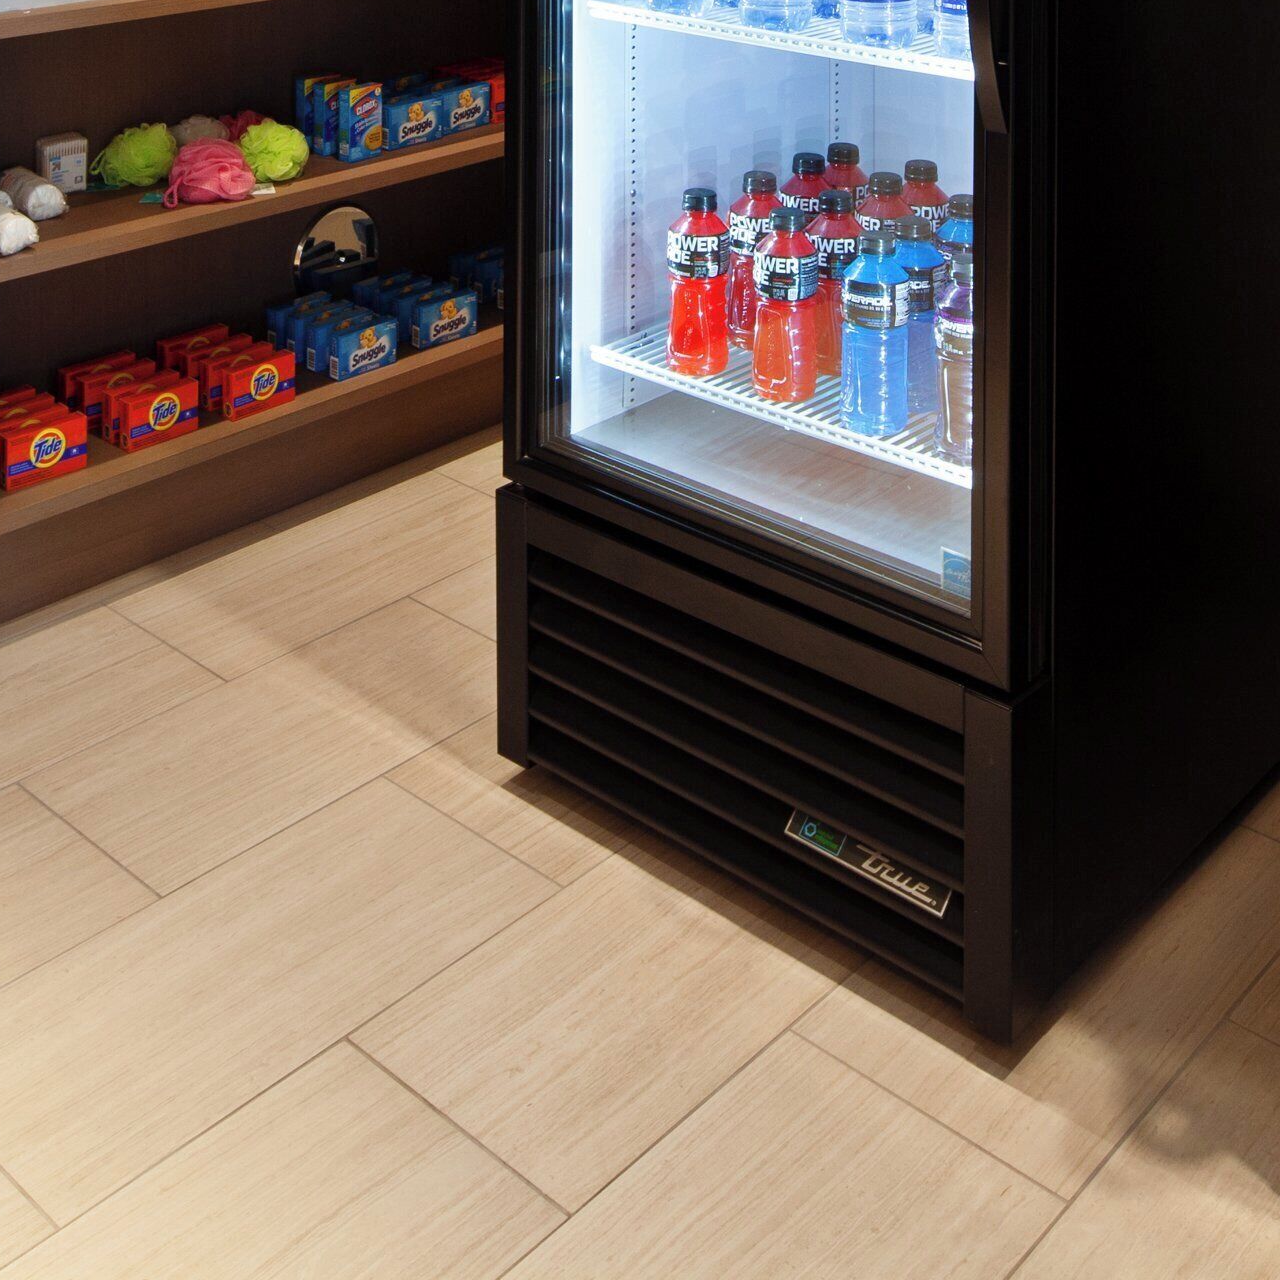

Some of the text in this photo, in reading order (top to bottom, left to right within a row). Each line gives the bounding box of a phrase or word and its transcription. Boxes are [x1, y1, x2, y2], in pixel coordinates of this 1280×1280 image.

[453, 105, 481, 124] Snuggle
[402, 118, 432, 139] Snuggle
[433, 314, 466, 336] Snuggle
[352, 343, 386, 367] Snuggle
[253, 372, 276, 395] Tide
[152, 402, 177, 426] Tide
[33, 440, 62, 464] Tide
